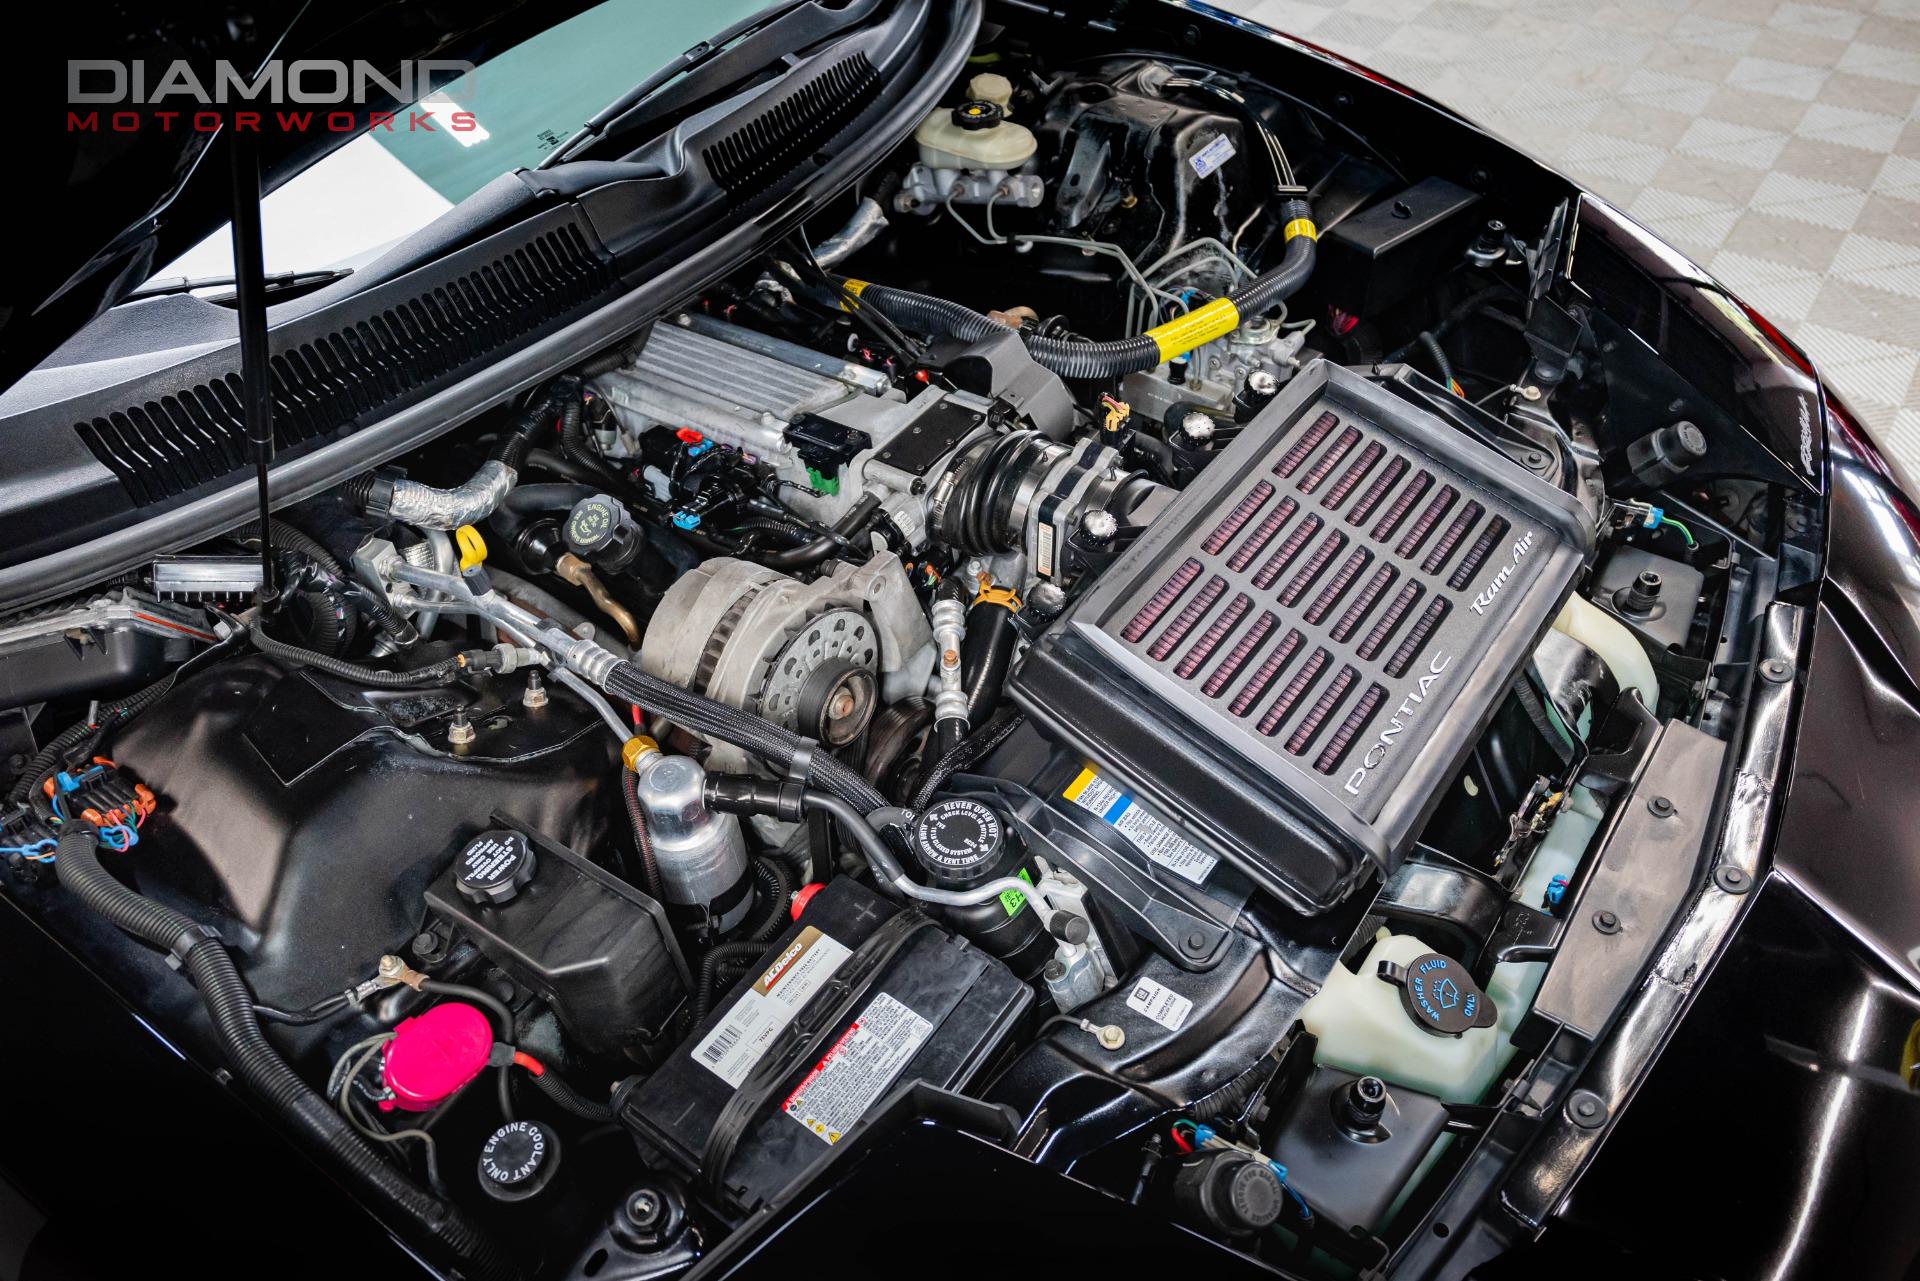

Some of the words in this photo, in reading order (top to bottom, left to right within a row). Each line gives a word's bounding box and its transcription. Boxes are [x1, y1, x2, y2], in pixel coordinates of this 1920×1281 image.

[587, 503, 609, 518] ENGINE
[600, 518, 609, 529] OIL
[1470, 563, 1517, 616] Ram
[1511, 531, 1534, 566] Air
[1343, 649, 1453, 796] PONTIAC
[920, 823, 929, 840] ALIGN
[940, 810, 960, 821] CHECK
[960, 810, 978, 820] LEVEL
[978, 824, 987, 844] BOTTLE
[943, 801, 972, 812] NEVER
[973, 804, 994, 824] OPEN
[987, 821, 998, 838] HOT
[465, 838, 494, 866] APPROVED
[466, 840, 484, 856] FLUID
[486, 843, 500, 855] USE
[492, 845, 505, 858] NOT
[504, 836, 515, 846] DO
[921, 839, 938, 859] ARROW
[932, 839, 950, 854] CLOSED
[949, 847, 973, 856] SYSTEM
[464, 858, 492, 880] OVERFILL
[471, 855, 486, 869] ONLY
[475, 846, 514, 880] STEERING
[487, 854, 517, 880] POWER
[943, 856, 961, 865] VENT
[961, 854, 979, 864] TUBE
[762, 941, 803, 986] ACDelco
[1419, 959, 1447, 974] FLUID
[1142, 986, 1161, 1013] CAMPAIGN
[1154, 992, 1174, 1020] COMPLETED
[1414, 977, 1440, 1021] WASHER
[483, 1121, 528, 1153] ENGINE
[512, 1126, 544, 1181] COOLANT
[482, 1158, 509, 1182] ONLY
